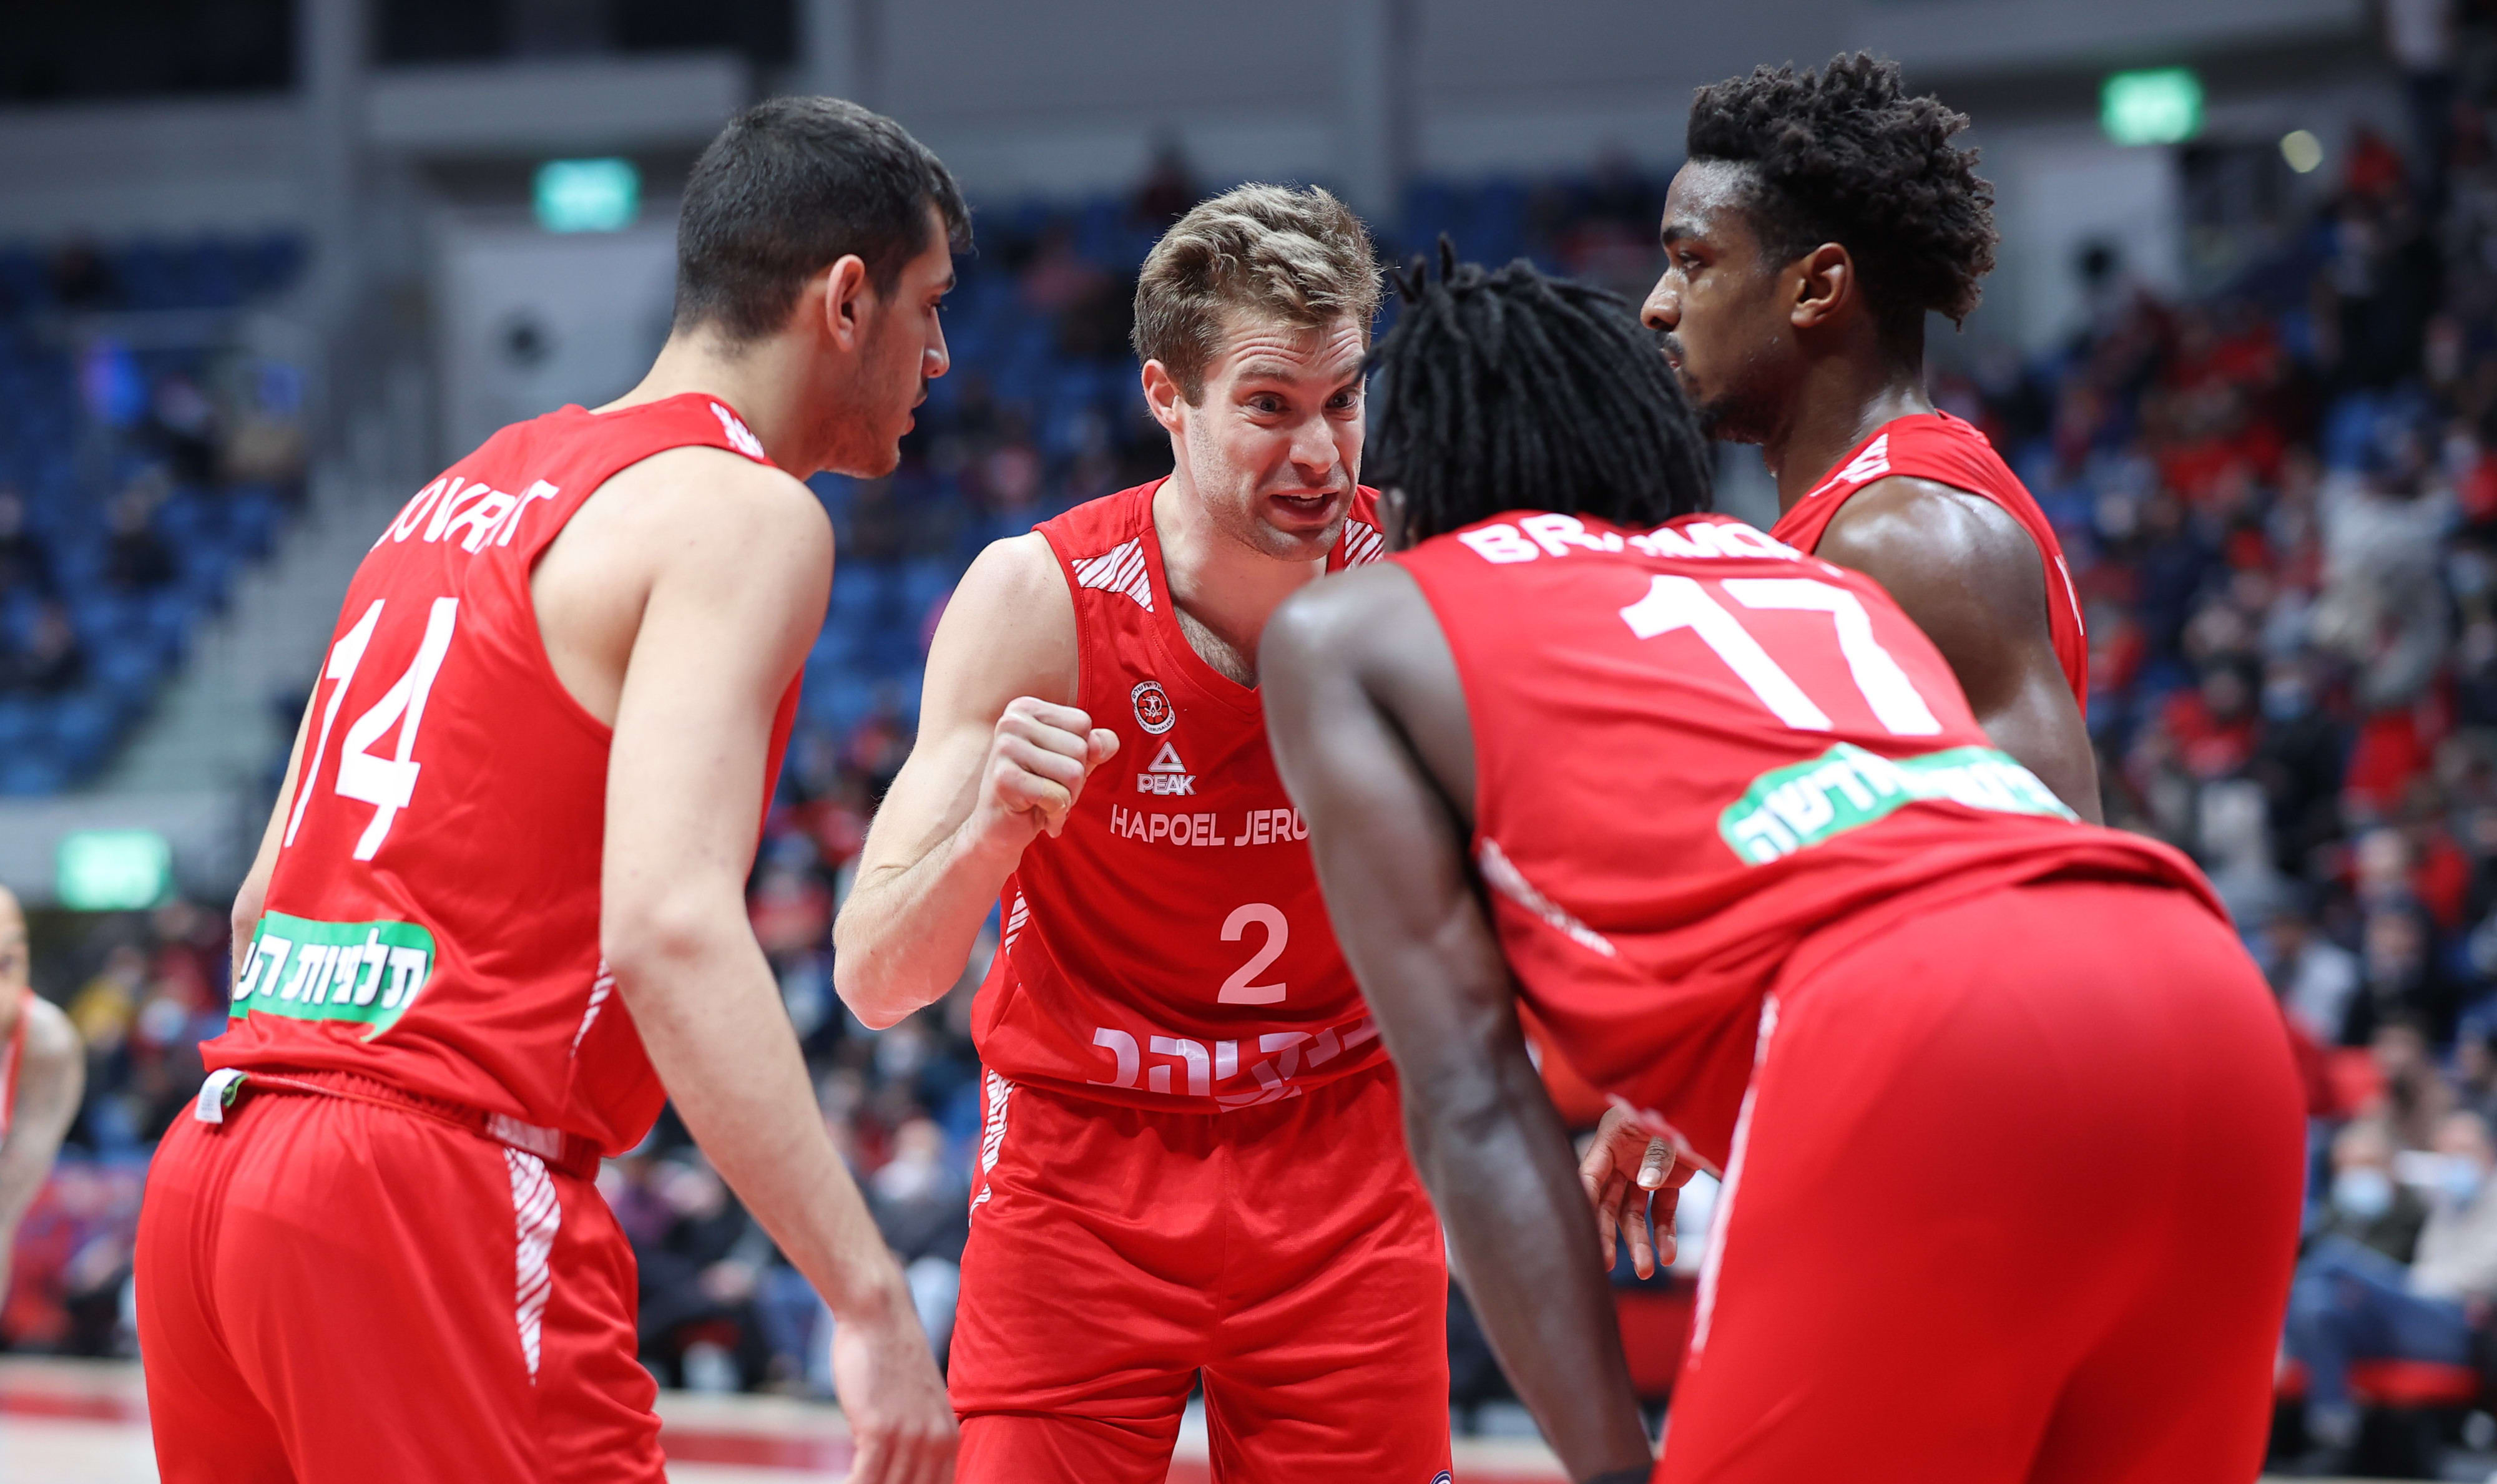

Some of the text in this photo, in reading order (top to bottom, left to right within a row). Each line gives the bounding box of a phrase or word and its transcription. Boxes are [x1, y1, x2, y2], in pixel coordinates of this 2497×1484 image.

[1619, 575, 1942, 735] 17
[283, 597, 459, 861] 14
[1110, 803, 1310, 847] HAPOEL JERU
[1137, 773, 1197, 796] PEAK
[1217, 903, 1289, 1004] 2
